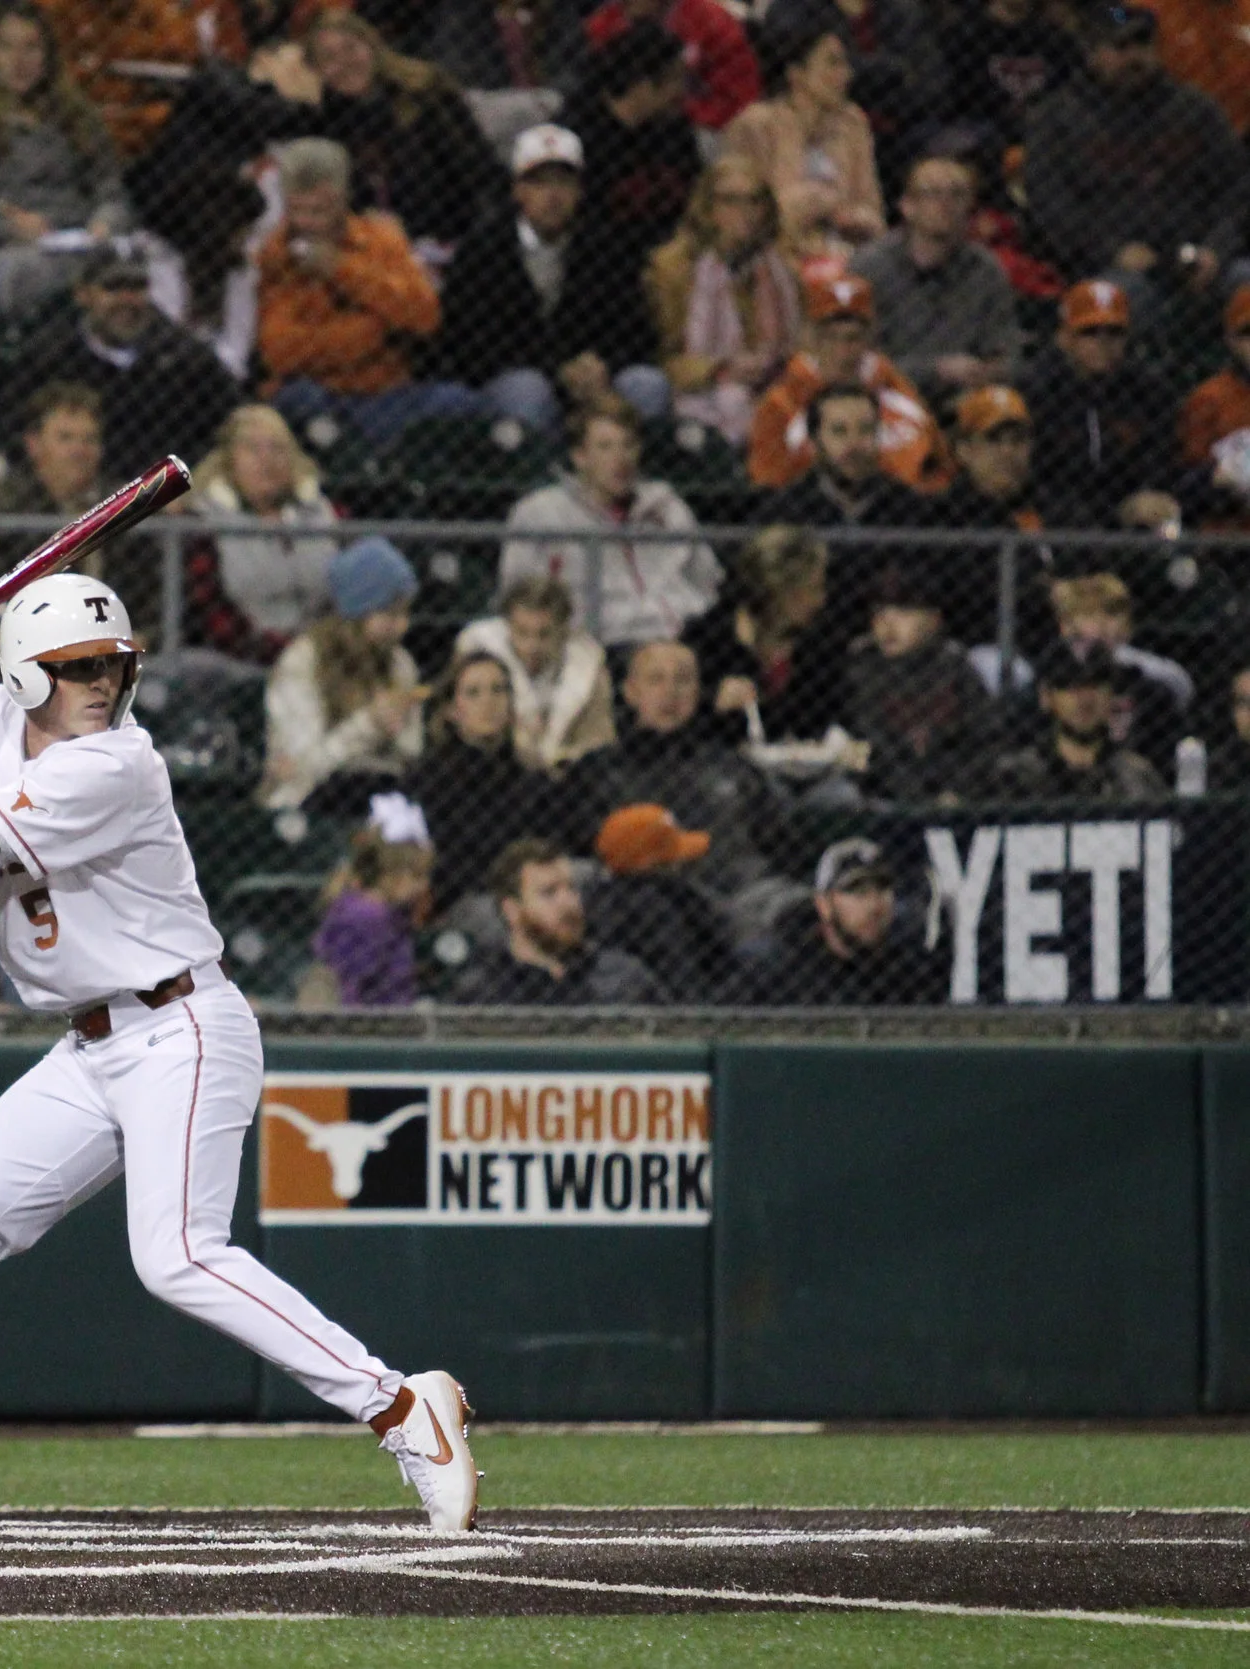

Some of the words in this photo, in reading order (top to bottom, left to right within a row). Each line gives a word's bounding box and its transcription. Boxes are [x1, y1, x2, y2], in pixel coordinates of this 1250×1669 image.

[83, 597, 110, 623] T
[20, 888, 58, 950] 5
[924, 820, 1172, 1003] YETI
[440, 1086, 710, 1141] LONGHORN
[441, 1153, 710, 1209] NETWORK
